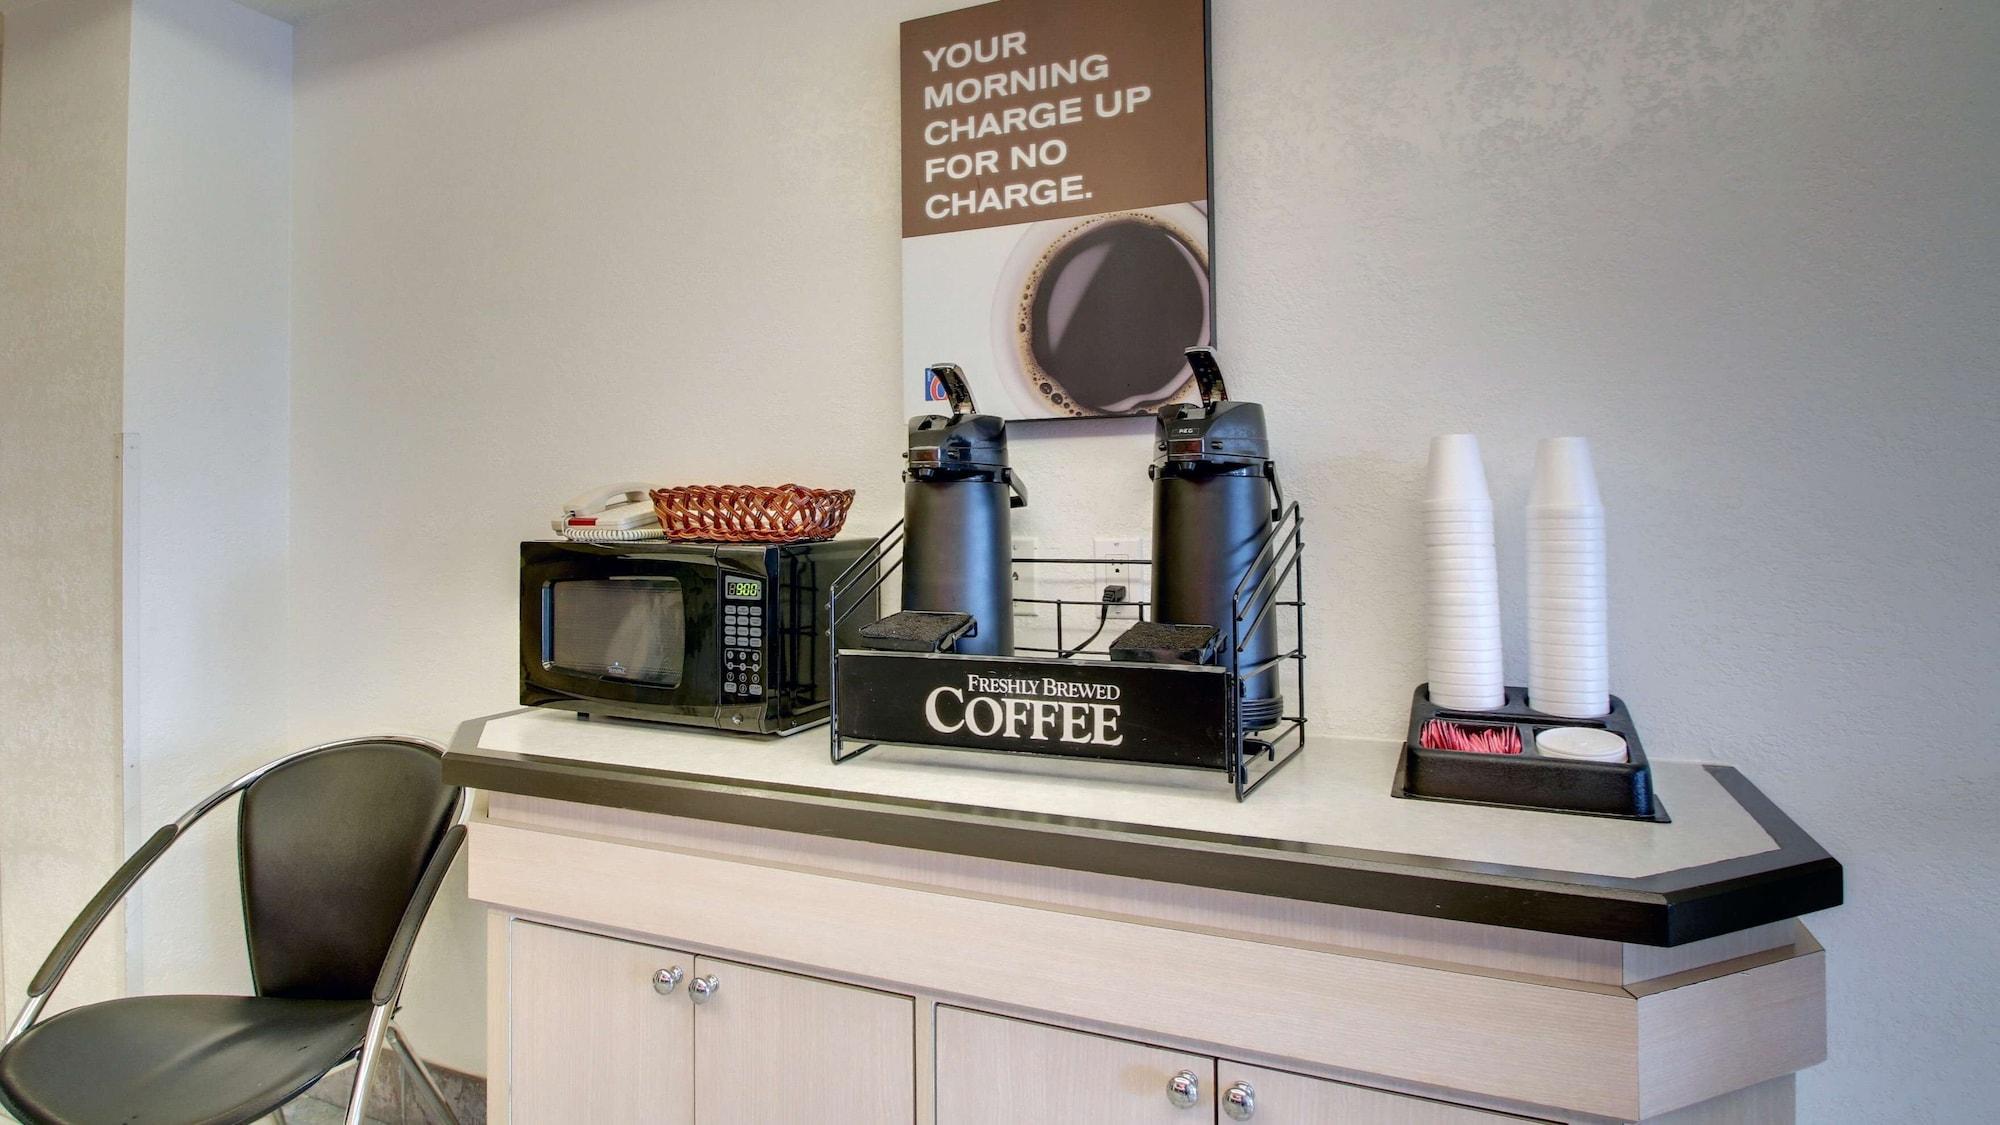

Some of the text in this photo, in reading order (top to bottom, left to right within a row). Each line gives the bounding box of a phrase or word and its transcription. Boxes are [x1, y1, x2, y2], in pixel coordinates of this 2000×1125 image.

[923, 32, 1027, 71] YOUR
[925, 55, 1108, 109] MORNING
[925, 86, 1151, 145] CHARGE UP
[926, 139, 1067, 183] FOR NO
[925, 175, 1093, 219] CHARGE.
[968, 675, 1120, 700] FRESHLY BREWED
[926, 687, 1123, 745] COFFEE
